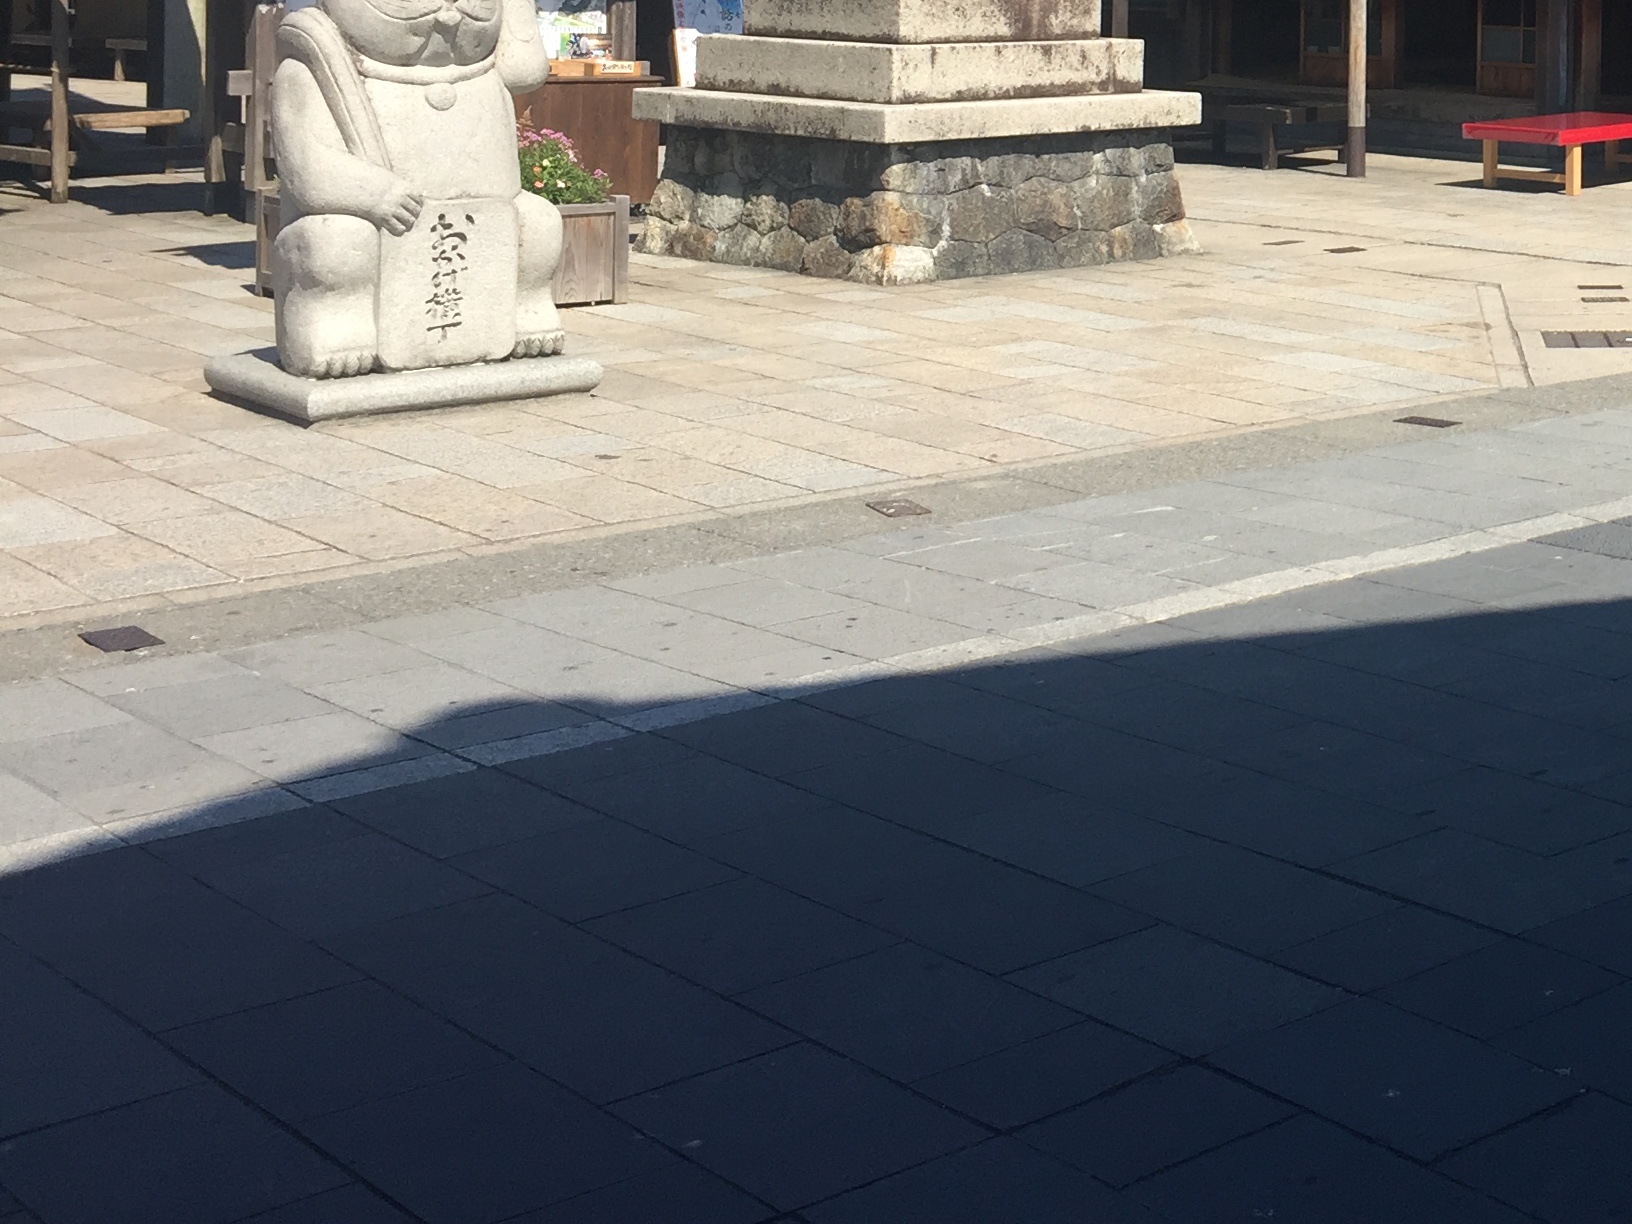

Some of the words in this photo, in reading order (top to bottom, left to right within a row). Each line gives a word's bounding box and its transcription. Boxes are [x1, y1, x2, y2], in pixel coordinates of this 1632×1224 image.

[425, 213, 475, 344] おかげ横丁
